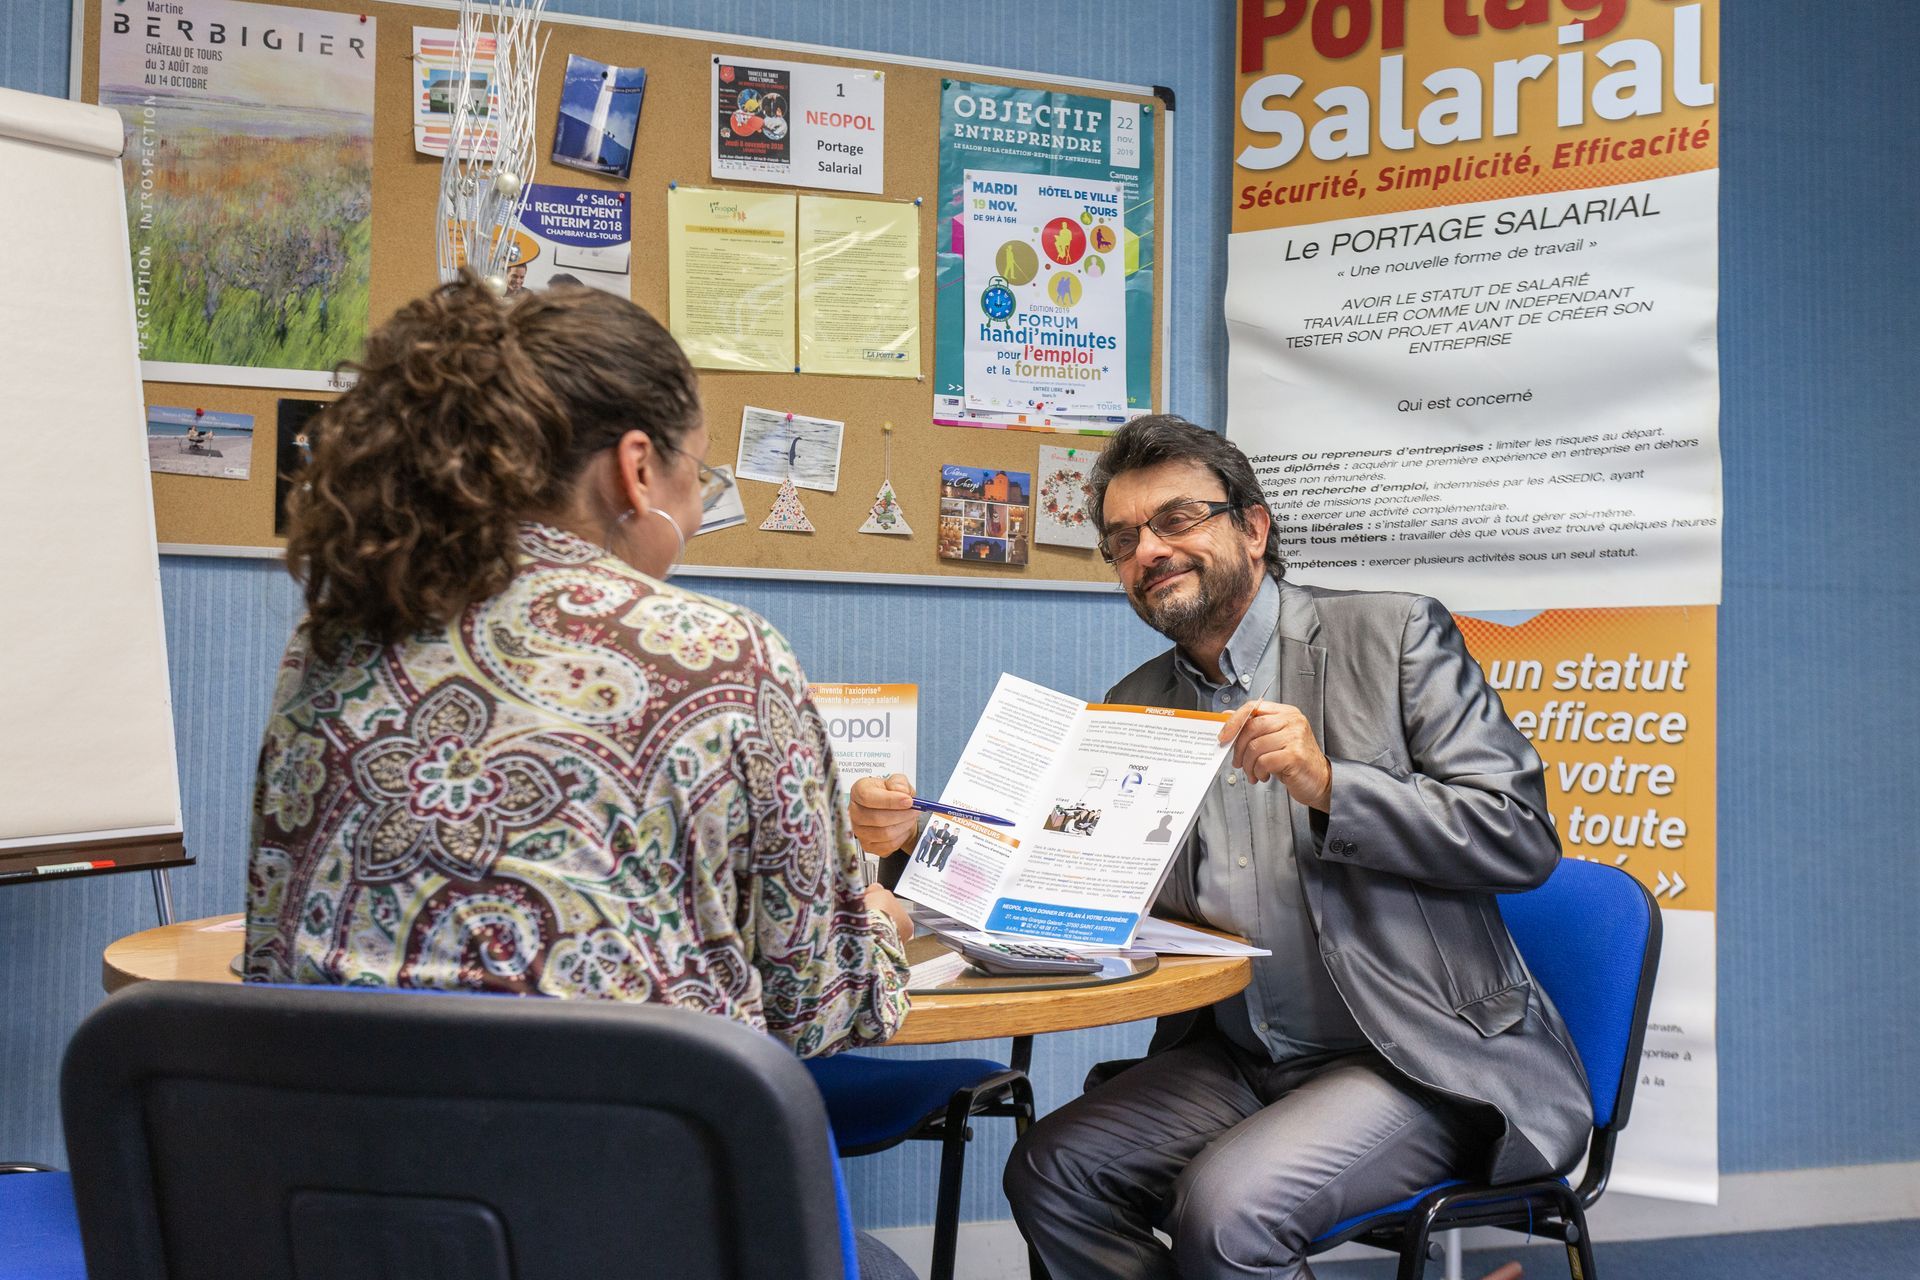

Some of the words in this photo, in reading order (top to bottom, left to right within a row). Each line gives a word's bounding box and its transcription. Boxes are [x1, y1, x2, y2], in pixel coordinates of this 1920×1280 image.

[147, 1, 184, 15] Martine
[113, 13, 365, 59] BERBIGIER
[145, 42, 185, 58] CHÂTEAU
[185, 47, 195, 59] DE
[197, 48, 223, 61] TOURS
[145, 58, 157, 71] du
[159, 59, 166, 71] 3
[168, 59, 190, 73] AOÛT
[192, 64, 209, 75] 2018
[145, 75, 156, 86] AU
[159, 76, 168, 86] 14
[171, 77, 208, 90] OCTOBRE
[836, 83, 845, 97] 1
[1236, 4, 1715, 170] Salarial
[806, 110, 876, 131] NEOPOL
[954, 95, 1102, 133] OBJECTIF
[1116, 117, 1133, 130] 22
[954, 124, 1102, 153] ENTREPRENDRE
[1117, 136, 1134, 144] nov.
[817, 140, 864, 155] Portage
[1117, 148, 1134, 156] 2019
[140, 95, 157, 230] INTROSPECTION
[818, 161, 862, 175] Salarial
[1239, 170, 1367, 209] Sécurité,
[1376, 147, 1541, 191] Simplicité,
[1552, 120, 1710, 169] Efficacité
[1110, 170, 1138, 181] Campus
[973, 181, 1018, 196] MARDI
[1039, 185, 1072, 199] HÔTEL
[1074, 191, 1088, 201] DE
[1090, 192, 1118, 204] VILLE
[591, 194, 622, 206] Salon
[973, 199, 986, 210] 19
[988, 200, 1018, 212] NOV.
[535, 202, 622, 219] RECRUTEMENT
[974, 214, 984, 222] DE
[997, 214, 1003, 223] À
[1004, 216, 1017, 224] 16H
[1084, 206, 1118, 218] TOURS
[540, 215, 590, 229] INTERIM
[593, 219, 622, 231] 2018
[1285, 240, 1319, 261] Le
[1331, 215, 1485, 256] PORTAGE
[1494, 193, 1661, 236] SALARIAL
[546, 228, 622, 240] CHAMBRAY-LES-TOURS
[1350, 265, 1380, 277] Une
[1386, 255, 1450, 273] nouvelle
[1454, 252, 1502, 265] forme
[1508, 247, 1528, 260] de
[1534, 239, 1583, 256] travail
[138, 245, 151, 350] PERCEPTION
[1342, 295, 1391, 311] AVOIR
[1396, 293, 1416, 305] LE
[1421, 286, 1484, 303] STATUT
[1488, 283, 1512, 296] DE
[1516, 272, 1590, 292] SALARIÉ
[1304, 312, 1398, 330] TRAVAILLER
[1403, 304, 1470, 322] COMME
[1475, 302, 1500, 314] UN
[1506, 287, 1634, 310] INDEPENDANT
[1018, 314, 1078, 328] FORUM
[1286, 334, 1343, 349] TESTER
[1347, 330, 1382, 342] SON
[1388, 323, 1452, 340] PROJET
[1456, 315, 1513, 333] AVANT
[1518, 312, 1542, 325] DE
[1548, 306, 1608, 323] CRÉER
[1614, 301, 1654, 316] SON
[1409, 333, 1512, 354] ENTREPRISE
[998, 350, 1021, 360] pour
[986, 365, 996, 375] et
[1002, 365, 1010, 376] la
[328, 380, 356, 389] TOUR
[1398, 400, 1422, 412] Qui
[1428, 397, 1451, 410] est
[1456, 389, 1532, 407] concerné
[1284, 462, 1340, 474] diplômés
[1402, 458, 1422, 467] une
[1482, 451, 1546, 464] expérience
[1551, 450, 1566, 458] en
[1570, 443, 1630, 457] entreprise
[1634, 442, 1650, 450] en
[1654, 437, 1698, 450] dehors
[1302, 452, 1317, 460] ou
[1321, 448, 1392, 460] repreneurs
[1535, 438, 1552, 446] les
[1556, 434, 1599, 446] risques
[1300, 476, 1320, 484] non
[1302, 484, 1366, 496] recherche
[1503, 478, 1524, 488] par
[1528, 476, 1544, 486] les
[1610, 469, 1645, 481] ayant
[1307, 500, 1320, 508] de
[1324, 497, 1371, 506] missions
[1302, 512, 1342, 520] exercer
[1346, 510, 1366, 518] une
[1312, 522, 1363, 532] libérales
[1430, 518, 1458, 526] sans
[1462, 514, 1489, 525] avoir
[1506, 514, 1528, 522] tout
[1311, 536, 1336, 544] tous
[1341, 533, 1387, 543] métiers
[1400, 530, 1446, 541] travailler
[1519, 552, 1548, 562] sous
[1552, 552, 1566, 560] un
[1570, 548, 1596, 560] seul
[1490, 659, 1543, 690] un
[1552, 652, 1689, 690] statut
[1145, 708, 1175, 716] PRINCIPES
[1513, 700, 1688, 743] efficace
[1558, 756, 1676, 795] votre
[1568, 806, 1687, 848] toute
